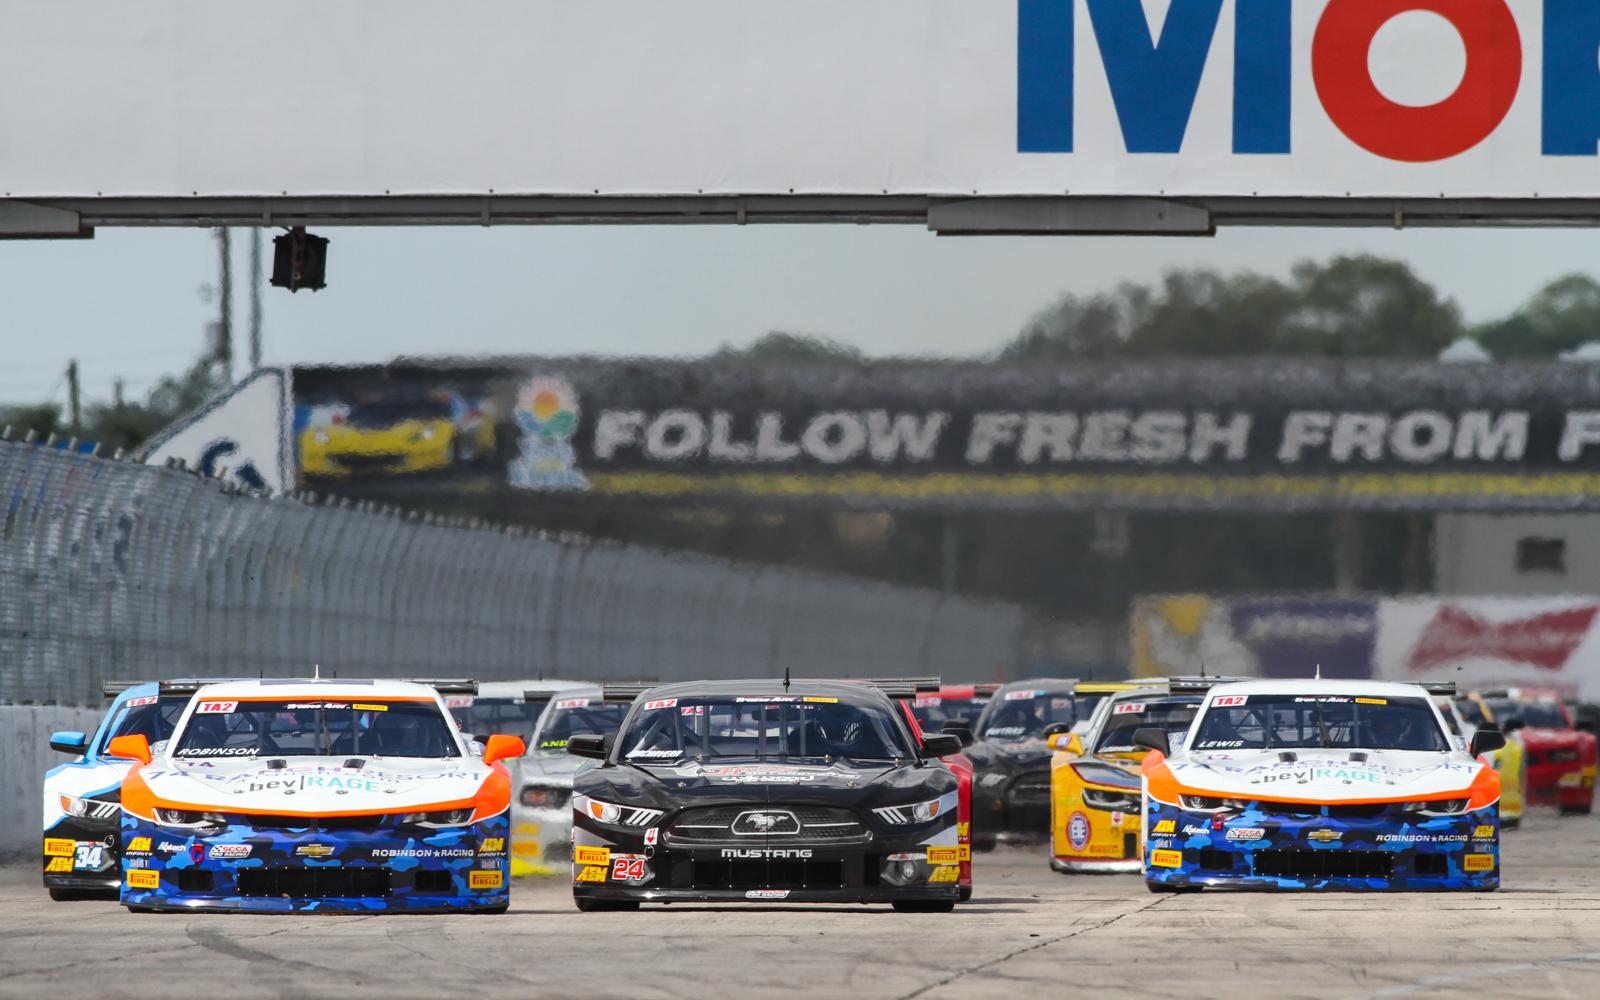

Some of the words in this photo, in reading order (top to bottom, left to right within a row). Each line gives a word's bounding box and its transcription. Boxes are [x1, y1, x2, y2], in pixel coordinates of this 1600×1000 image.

[594, 408, 950, 462] FOLLOW
[965, 410, 1252, 463] FRESH
[1277, 409, 1530, 462] FROM
[129, 697, 157, 707] TA2
[649, 700, 676, 709] TA2
[1217, 697, 1244, 705] TA2
[204, 703, 232, 711] TA2
[1118, 704, 1142, 712] TA2
[1152, 820, 1176, 833] AEM
[1472, 825, 1494, 837] AEM
[1376, 834, 1430, 842] ROBINSON
[1438, 834, 1468, 842] RACING
[48, 842, 72, 853] PIRELLI
[127, 837, 152, 851] AEM
[158, 842, 187, 852] Katech
[479, 838, 504, 851] AEM
[75, 846, 102, 868] 34
[372, 849, 431, 857] ROBINSON
[441, 849, 474, 857] RACING
[580, 850, 607, 862] PIRELLI
[721, 849, 812, 857] MUSTANG
[930, 849, 957, 861] PIRELLI
[1155, 853, 1179, 864] PIRELLI
[1467, 858, 1491, 868] PIRELLI
[576, 866, 608, 882] AEM
[612, 858, 644, 880] 24
[927, 866, 960, 882] AEM
[130, 873, 156, 885] PIRELLI
[473, 874, 499, 885] PIRELLI
